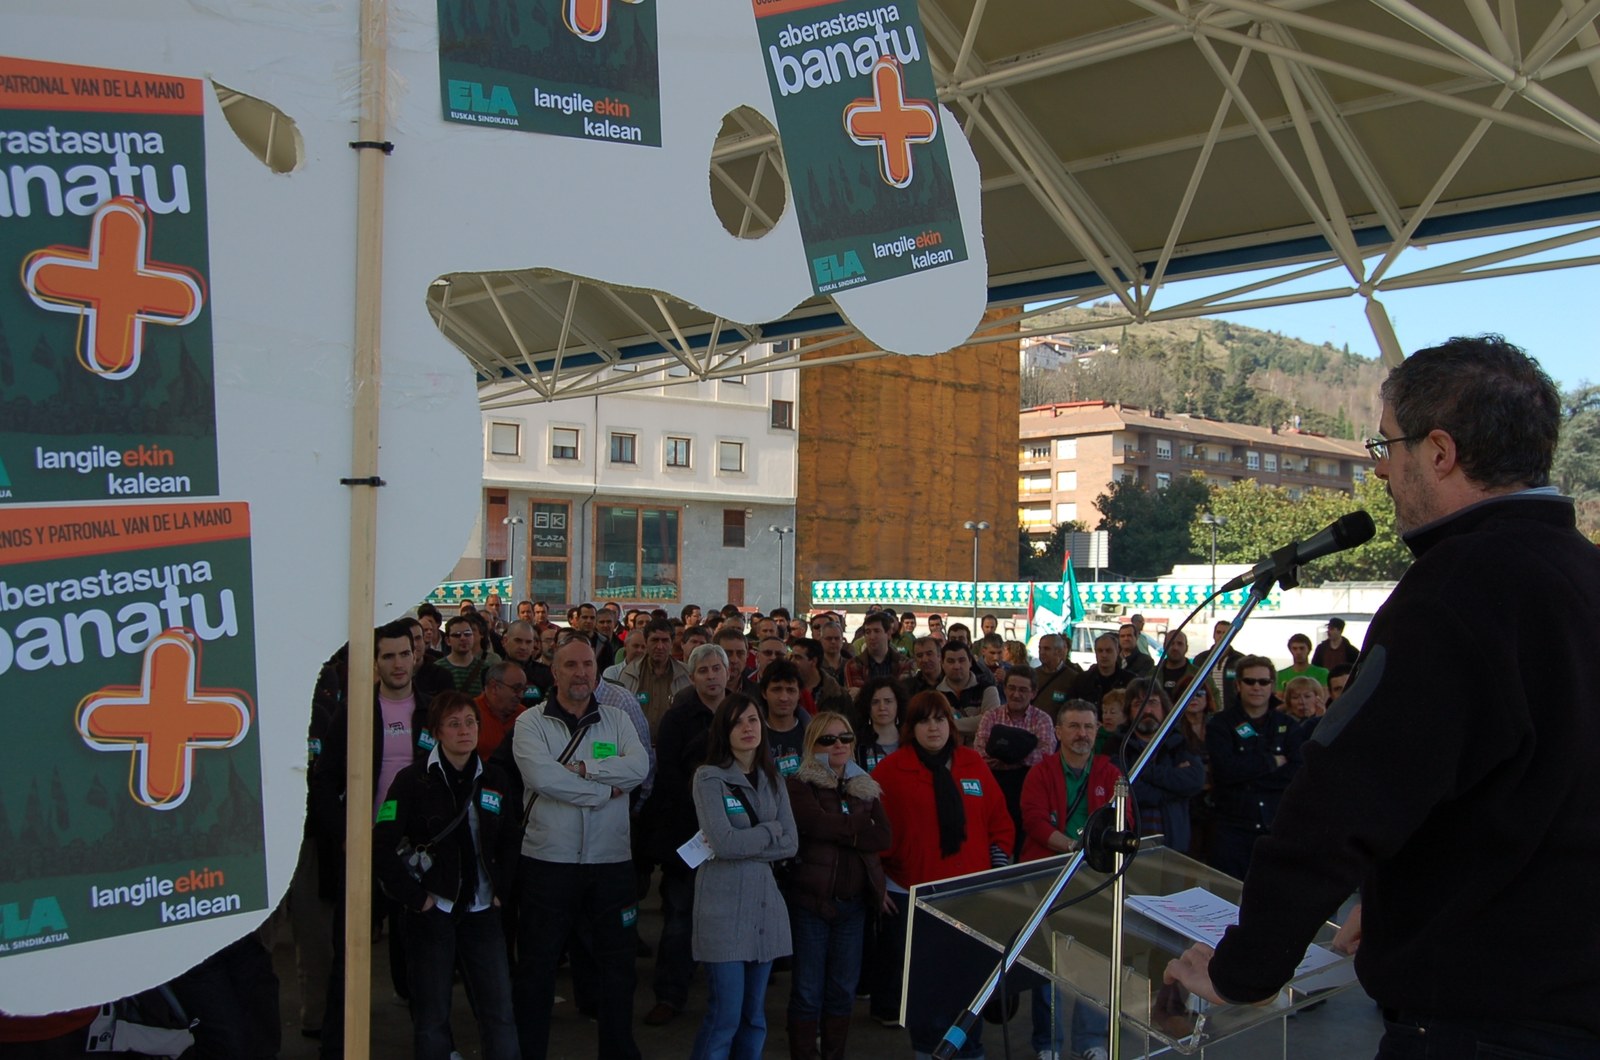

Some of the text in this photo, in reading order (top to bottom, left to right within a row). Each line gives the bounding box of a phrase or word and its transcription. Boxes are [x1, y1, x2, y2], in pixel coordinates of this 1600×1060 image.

[779, 5, 899, 48] aberastasuna
[769, 24, 920, 96] banatu
[72, 79, 100, 96] VAN
[104, 80, 122, 97] DE
[125, 81, 142, 98] LA
[146, 81, 185, 99] MANO
[448, 79, 519, 116] ELA
[450, 111, 519, 126] EUSKAL SINDIKATUA
[584, 117, 641, 141] kalean
[0, 152, 190, 217] natu
[813, 249, 865, 284] ELA
[911, 249, 954, 270] kalean
[819, 275, 867, 292] EUSKAL SINDIKATUA
[108, 472, 190, 494] kalean
[0, 508, 232, 548] NOS Y PATRONAL VAN DE LA MANO
[0, 560, 212, 611] berastasuna
[0, 896, 69, 939] LA
[161, 894, 241, 923] kalean
[12, 932, 69, 950] SINDIKATUA
